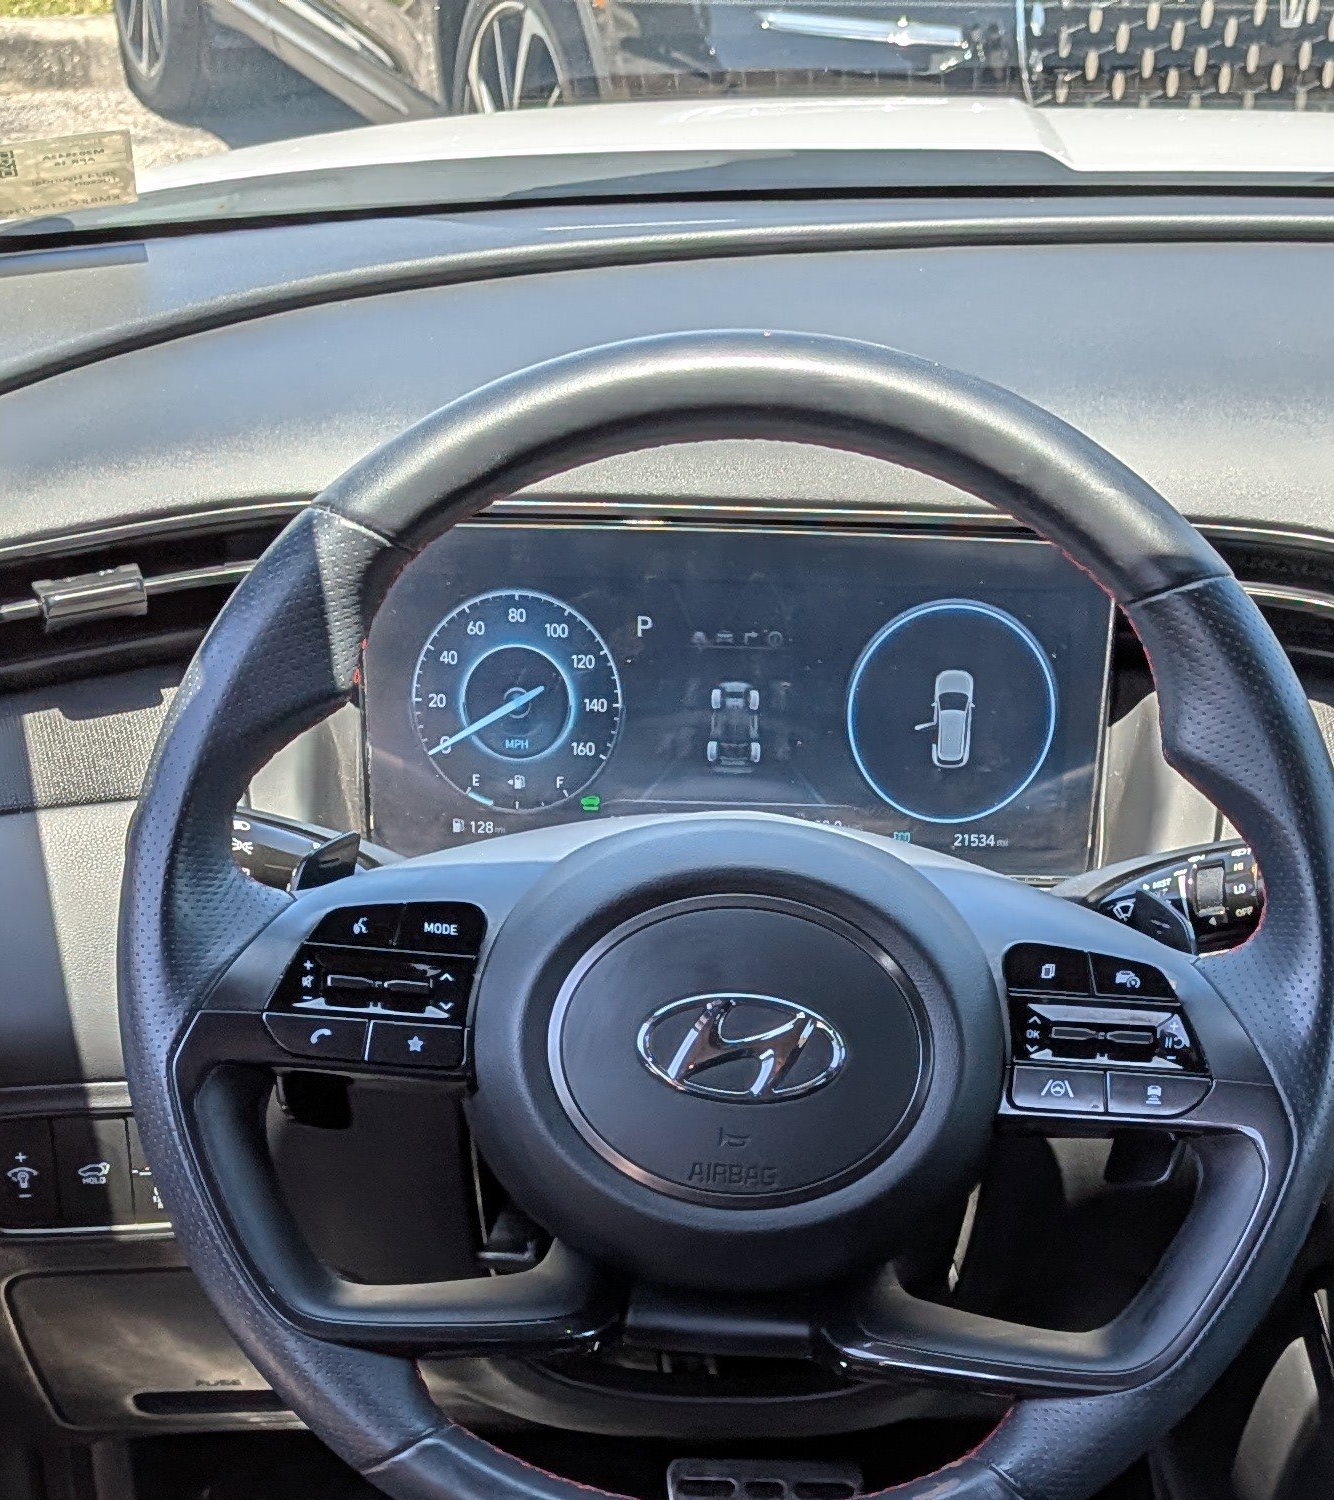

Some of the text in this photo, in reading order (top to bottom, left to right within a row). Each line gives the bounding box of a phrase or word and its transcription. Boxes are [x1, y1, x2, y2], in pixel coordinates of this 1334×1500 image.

[508, 608, 526, 622] 80
[467, 621, 485, 635] 60
[545, 623, 569, 638] 100
[636, 616, 653, 637] P
[440, 651, 458, 664] 40
[571, 655, 595, 669] 120
[428, 694, 446, 708] 20
[584, 699, 607, 712] 140
[505, 740, 529, 750] MPH
[571, 742, 595, 756] 160
[472, 774, 480, 787] E
[556, 776, 564, 789] F
[470, 821, 494, 834] 128
[953, 834, 996, 847] 21534
[1233, 883, 1246, 895] LO
[423, 921, 459, 936] MODE
[1026, 1029, 1040, 1040] OK
[687, 1161, 778, 1187] AIRBAG
